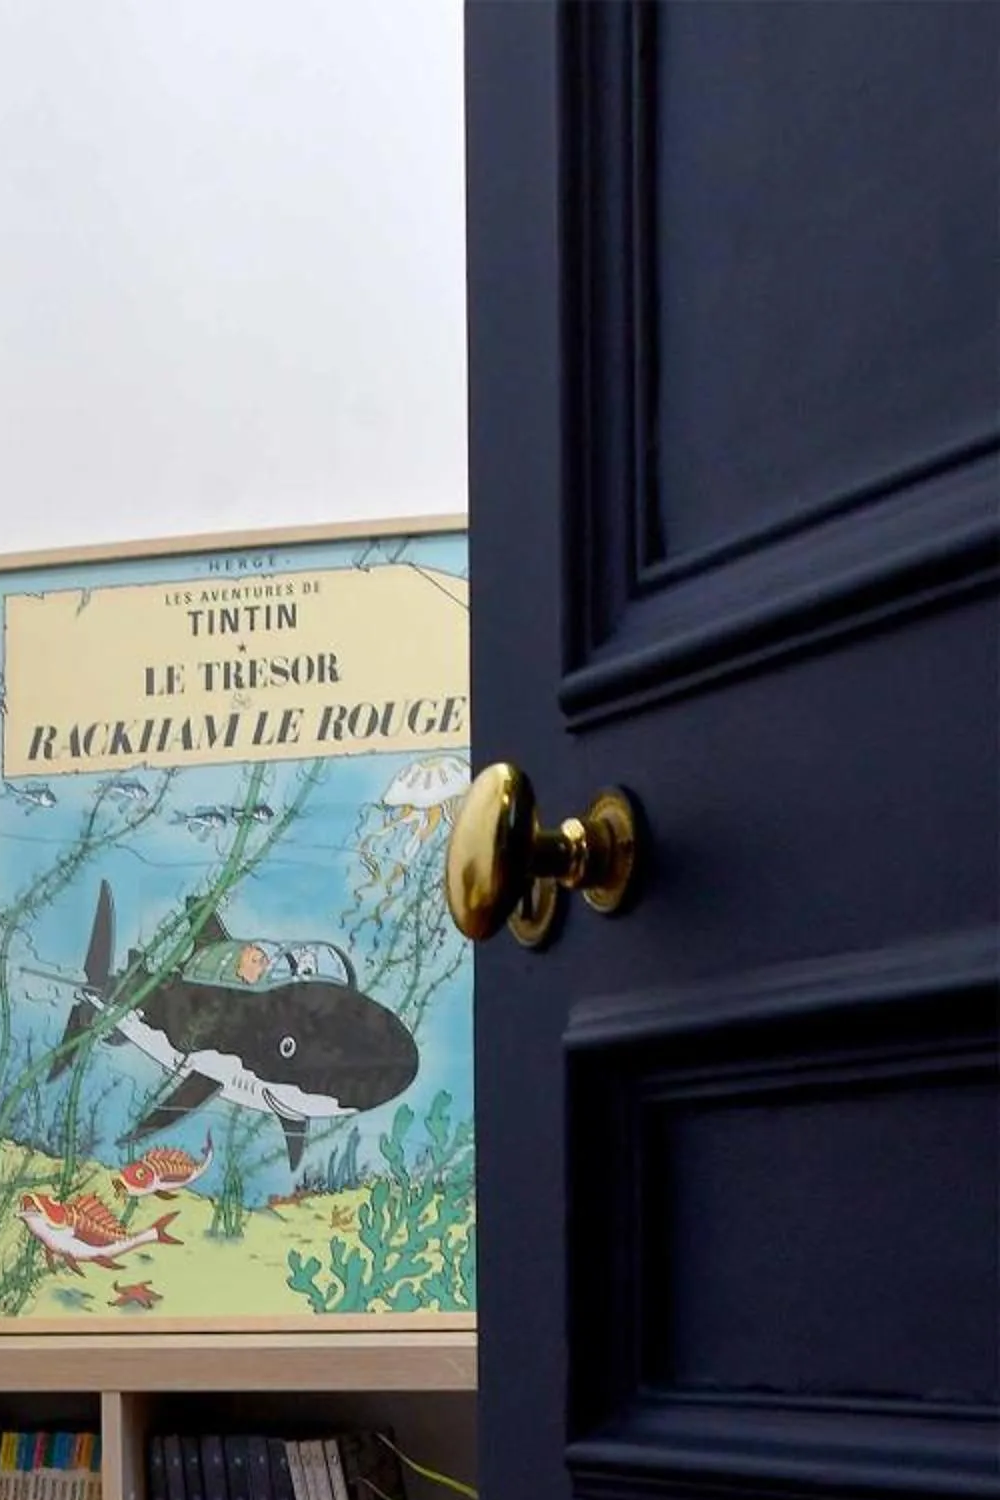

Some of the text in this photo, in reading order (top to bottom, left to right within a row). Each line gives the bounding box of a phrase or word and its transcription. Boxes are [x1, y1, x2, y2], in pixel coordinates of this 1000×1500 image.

[164, 580, 321, 607] LES AVENTURES DE
[187, 602, 298, 636] TINTIN
[143, 652, 342, 697] LE TRESOR
[27, 695, 468, 762] RACKHAM LE ROUGE
